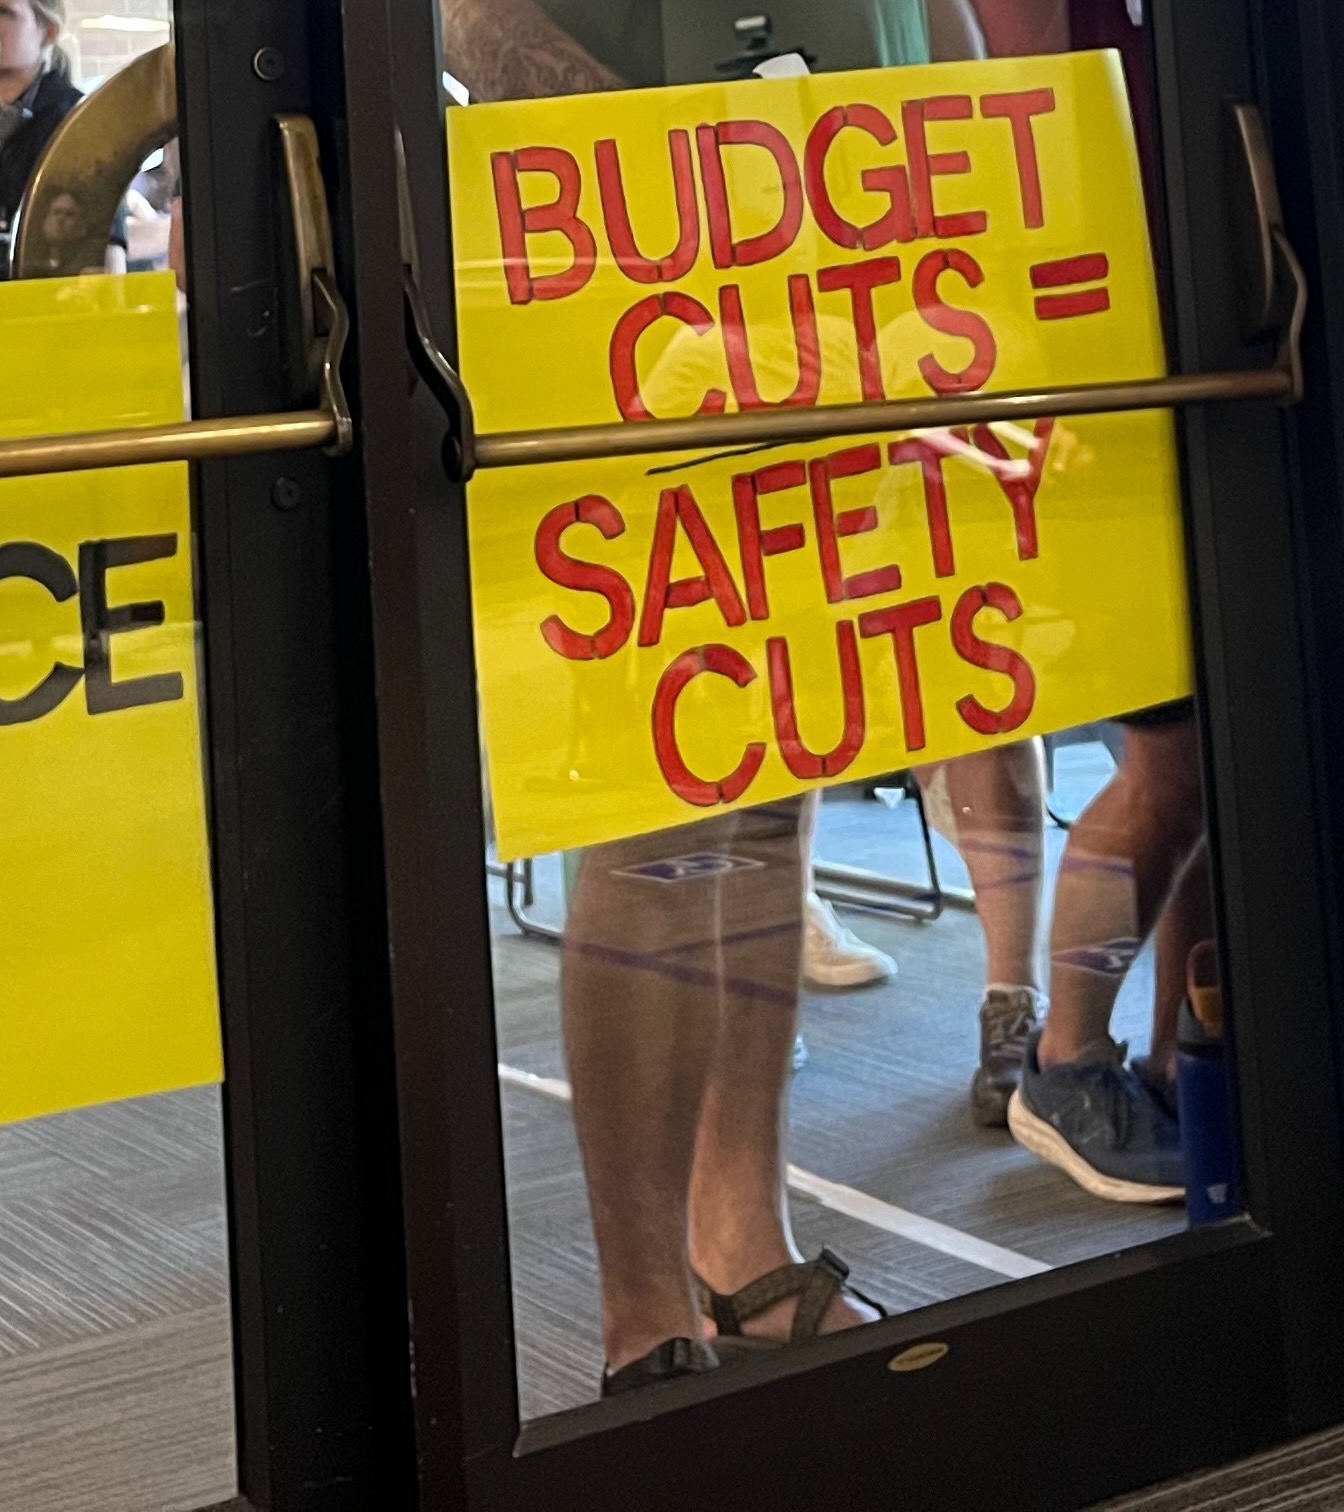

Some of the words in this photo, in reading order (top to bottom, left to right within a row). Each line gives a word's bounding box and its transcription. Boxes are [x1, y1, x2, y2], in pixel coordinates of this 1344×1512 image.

[490, 87, 1055, 305] BUDGET
[610, 248, 997, 426] CUTS
[534, 418, 1054, 661] SAFETY
[651, 581, 1036, 808] CUTS
